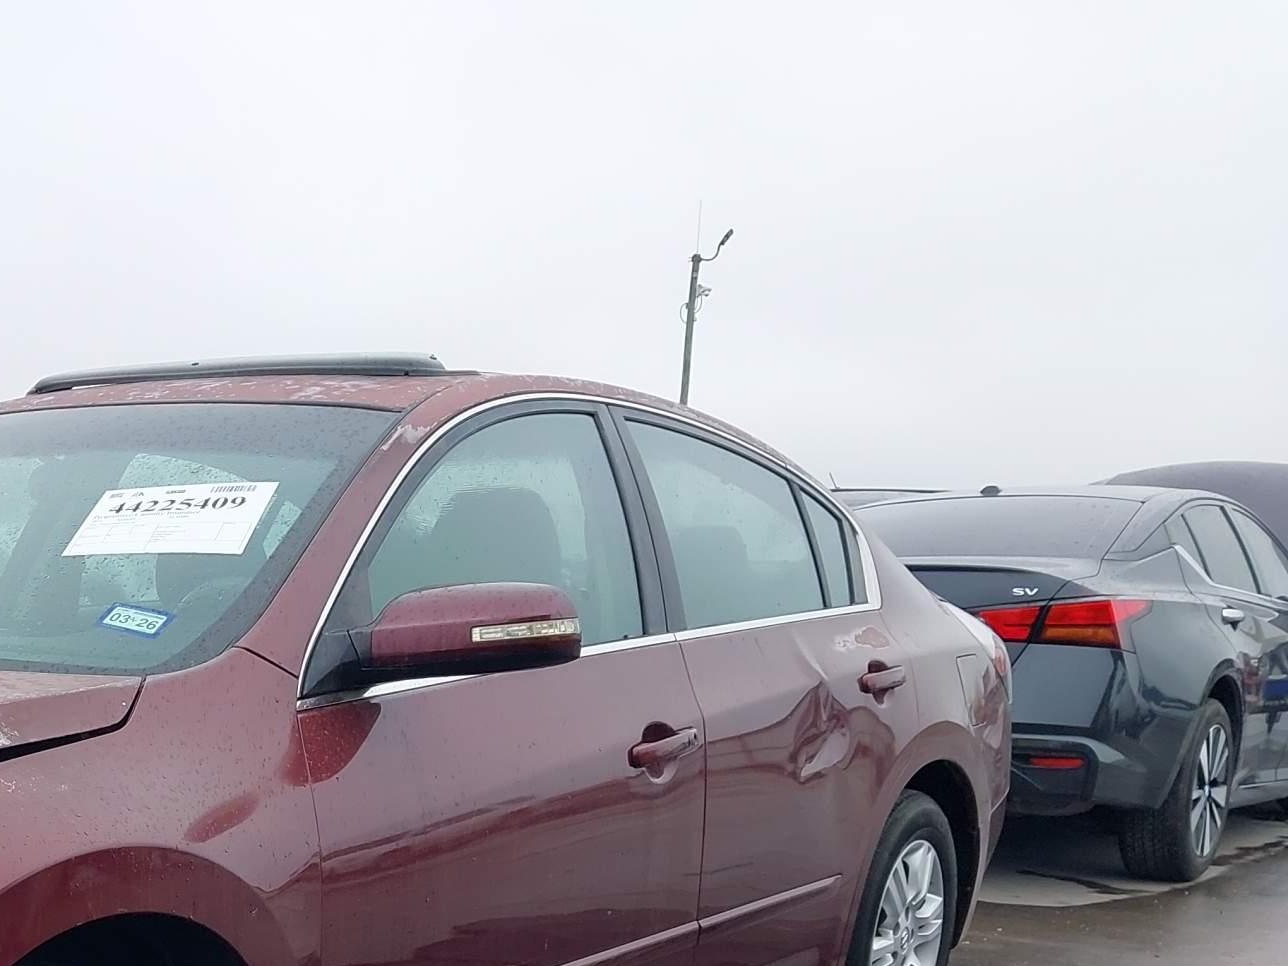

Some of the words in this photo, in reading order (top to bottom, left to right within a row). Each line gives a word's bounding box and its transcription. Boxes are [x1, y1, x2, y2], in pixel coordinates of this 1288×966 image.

[108, 496, 247, 515] 44225409
[1012, 587, 1039, 596] SV
[109, 612, 131, 624] 03
[136, 618, 159, 630] 26
